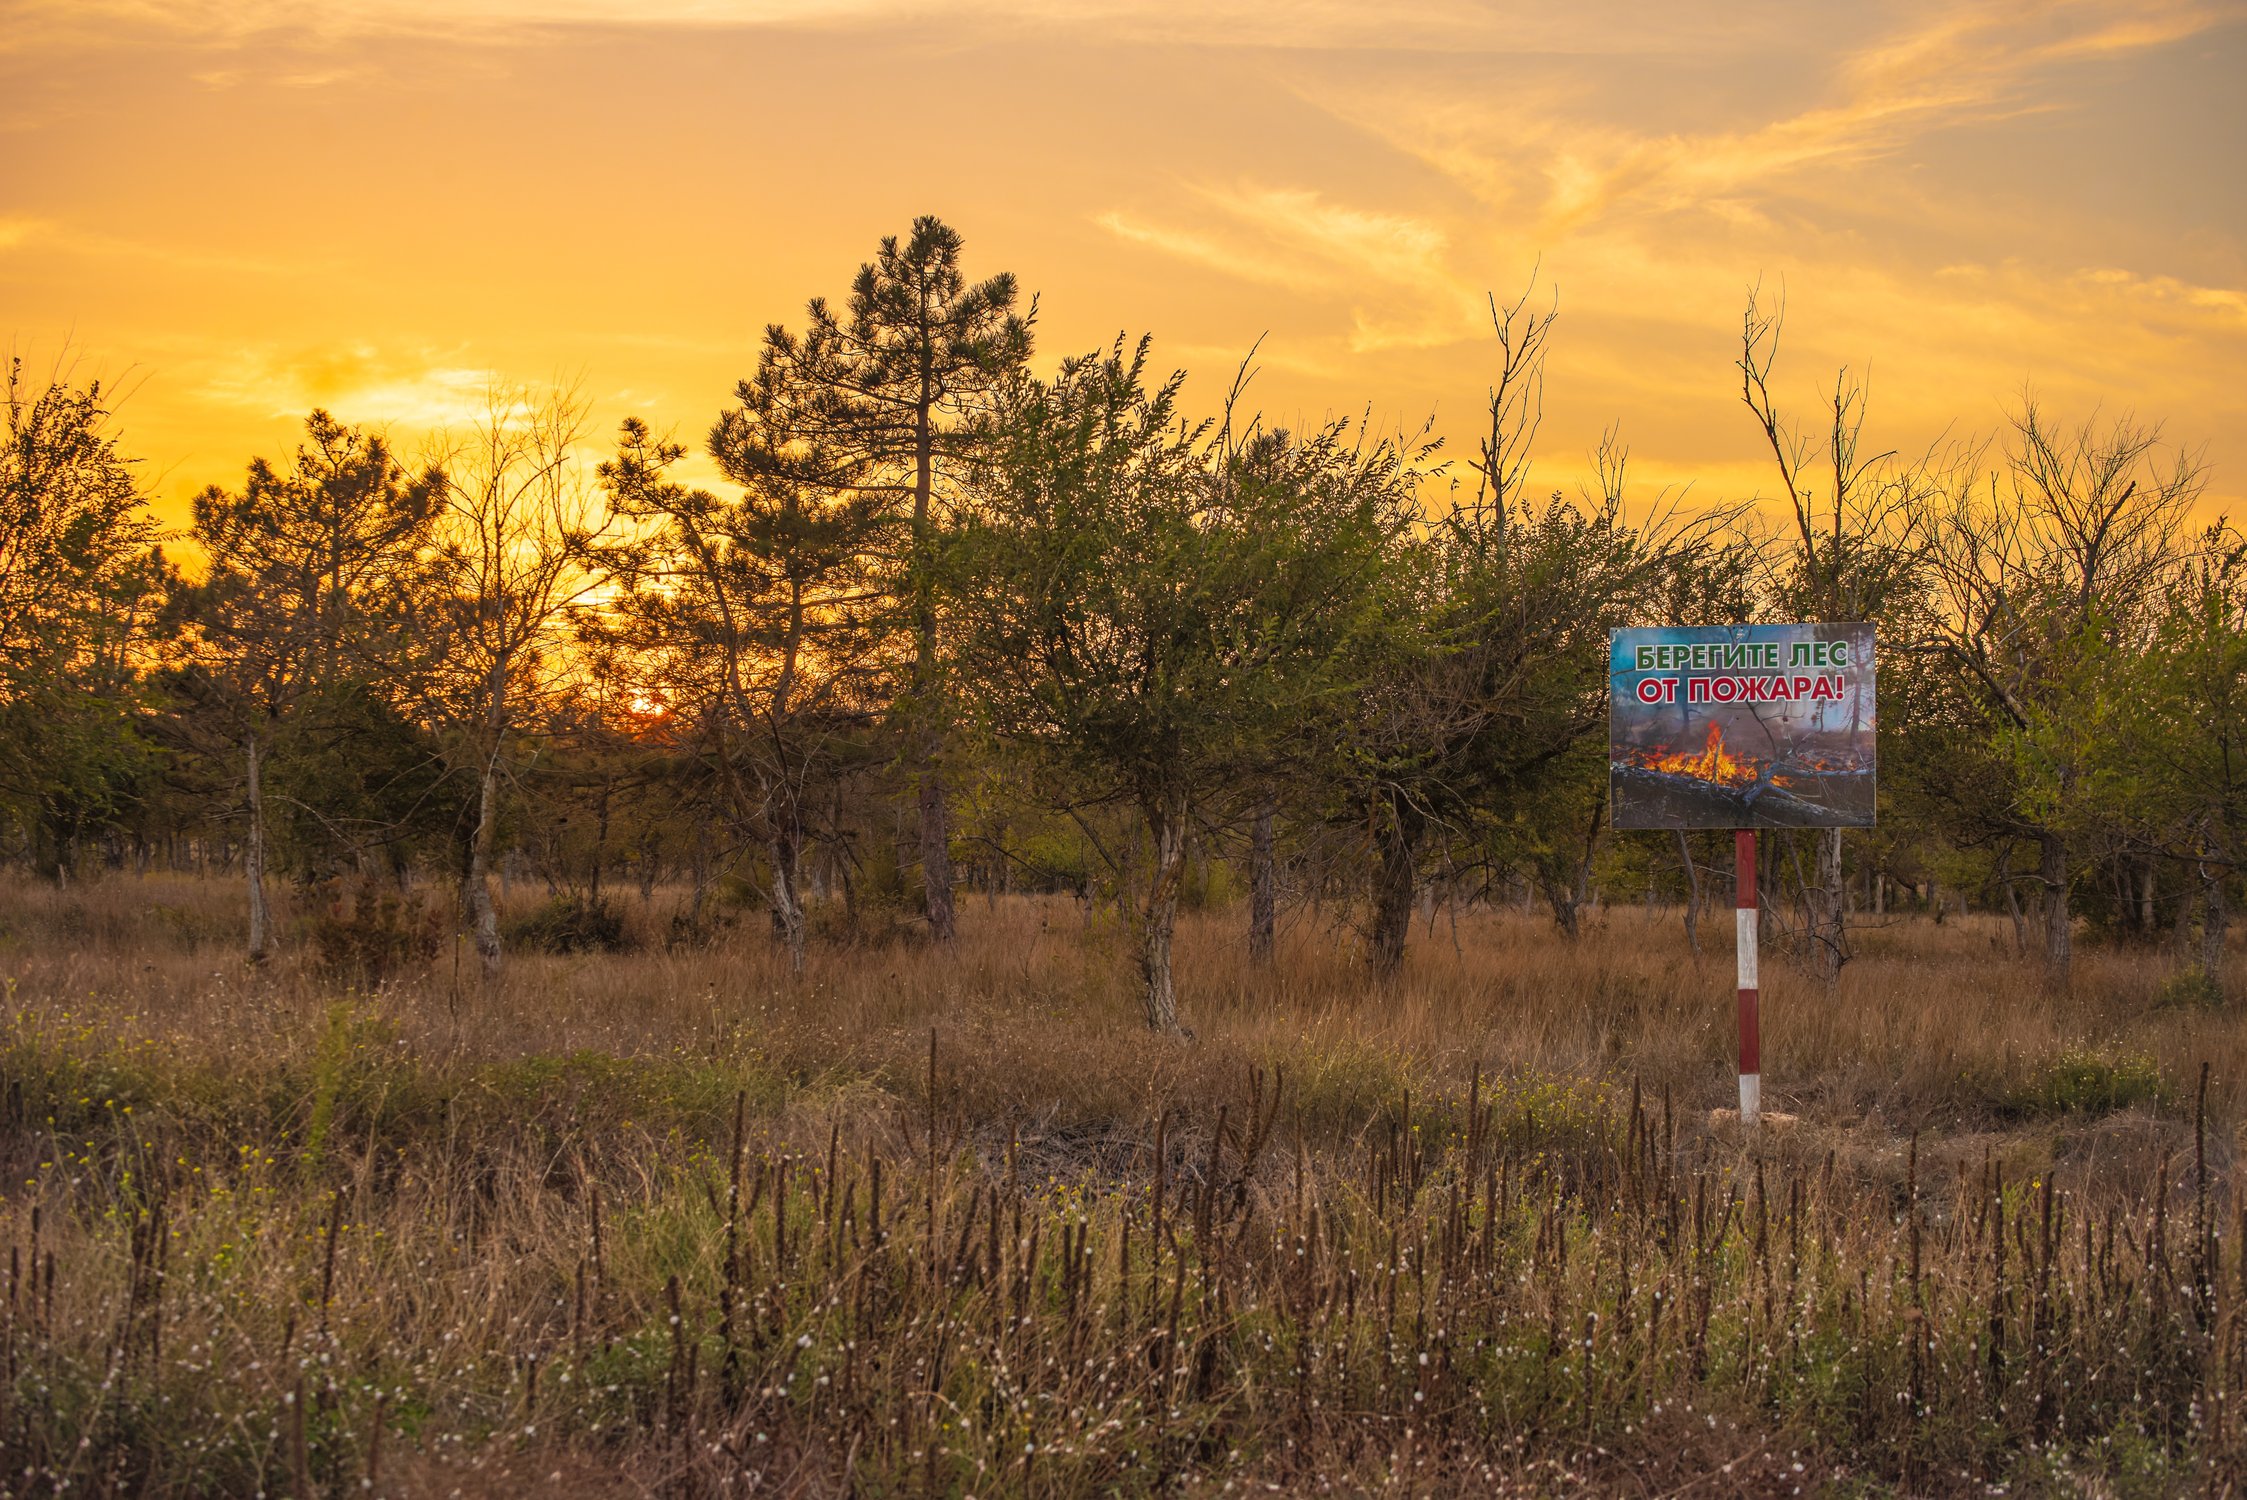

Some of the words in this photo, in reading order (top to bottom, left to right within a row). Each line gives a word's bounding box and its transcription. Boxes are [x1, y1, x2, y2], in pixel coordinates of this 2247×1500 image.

[1636, 643, 1779, 670] БЕРЕГИТЕ
[1788, 641, 1848, 668] ЛЕС
[1637, 677, 1679, 704] ОТ
[1688, 675, 1845, 703] ПОЖАРА!
